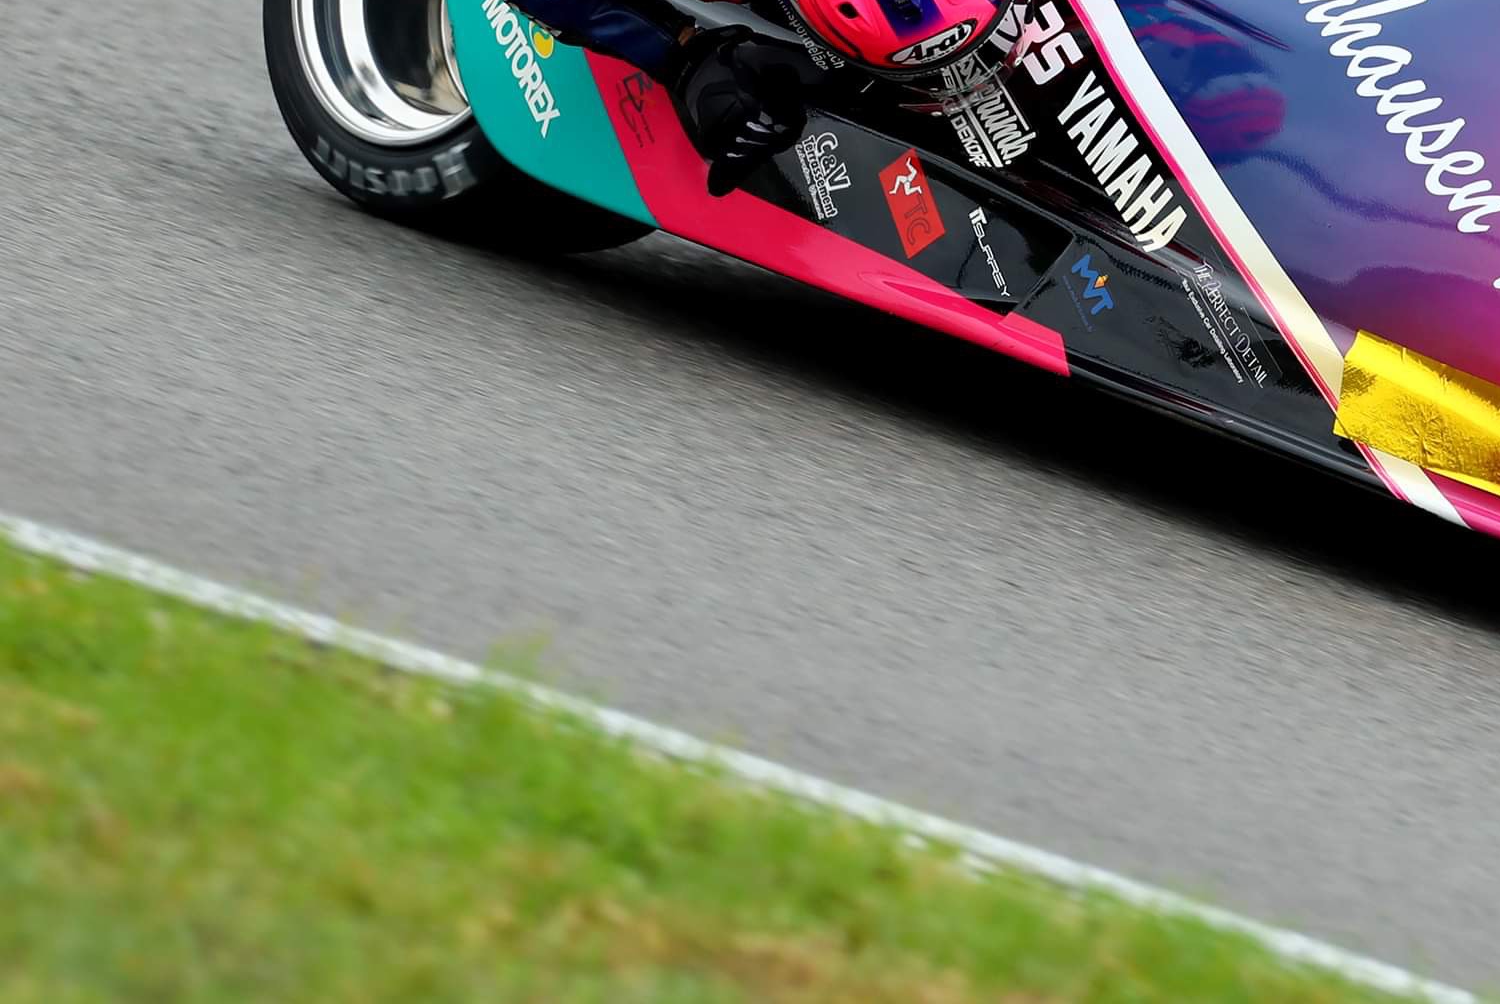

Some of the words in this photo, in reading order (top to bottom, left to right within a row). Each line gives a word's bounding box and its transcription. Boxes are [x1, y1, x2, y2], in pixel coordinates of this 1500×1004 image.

[893, 21, 974, 65] Arai
[1057, 72, 1188, 253] YAMAHA
[1202, 281, 1241, 336] PERFECT
[1235, 333, 1269, 389] DETAIL
[1209, 329, 1227, 355] Detailing
[1224, 354, 1244, 384] Laboratory
